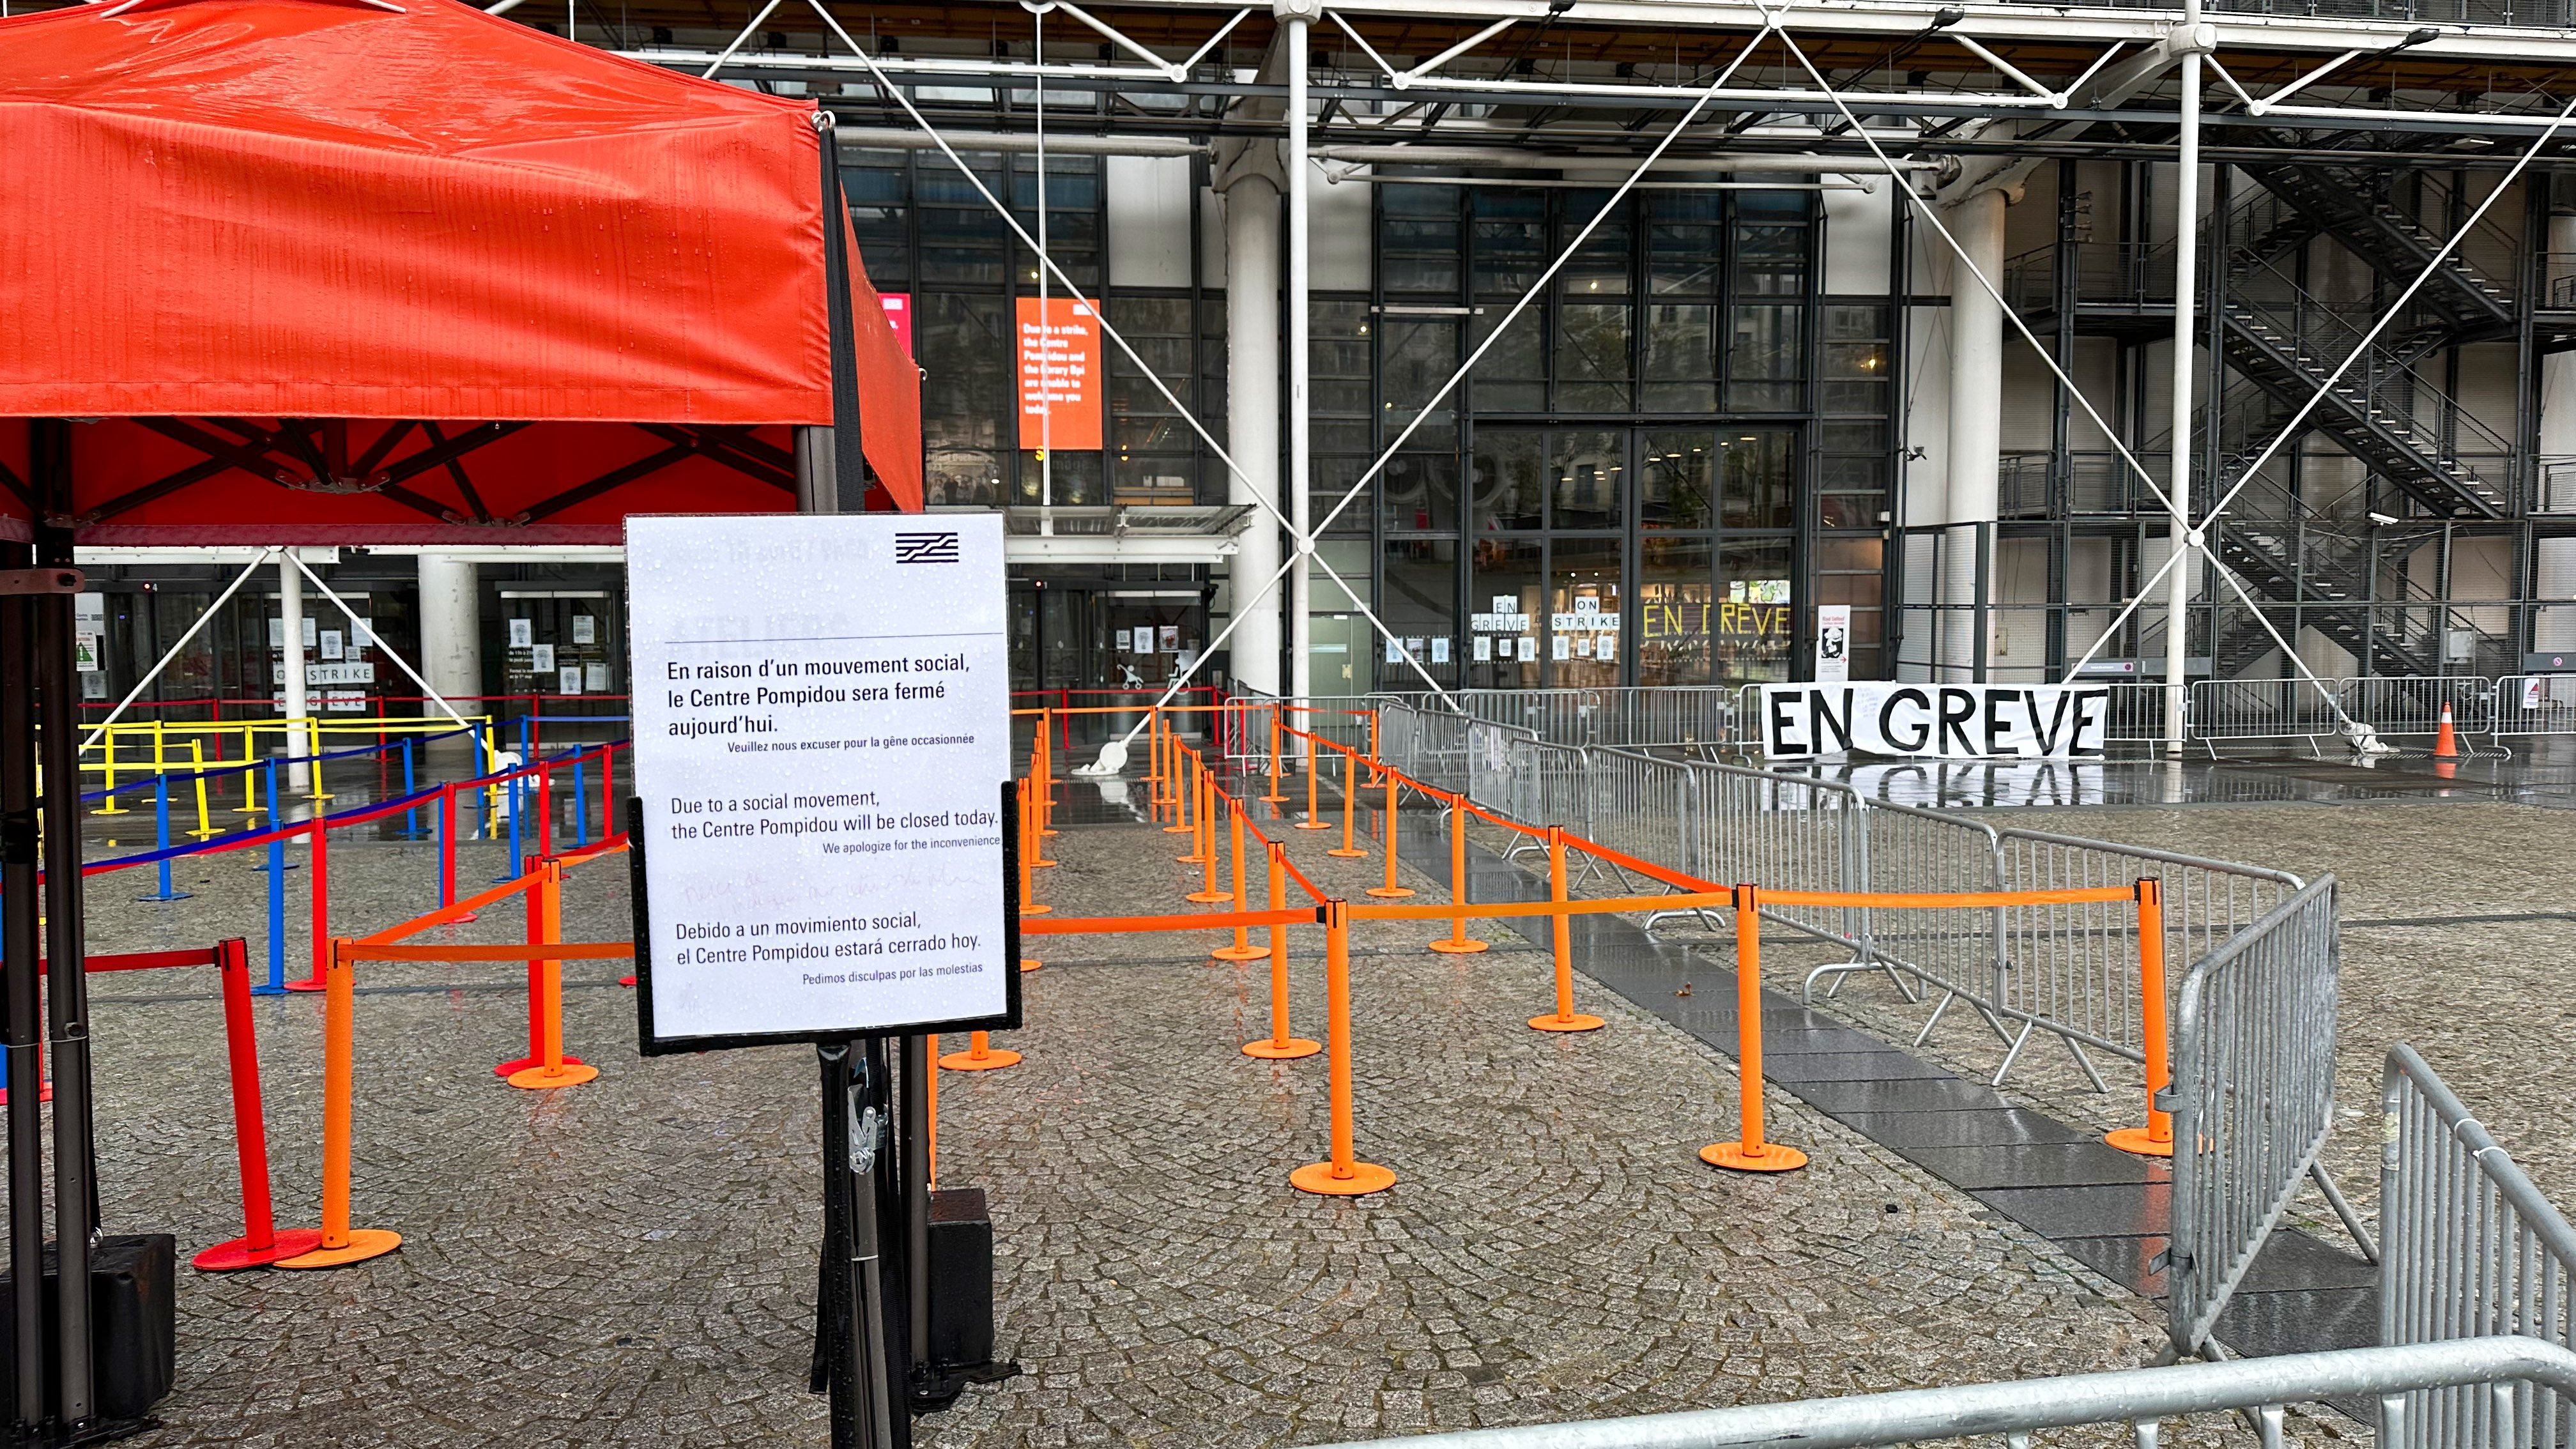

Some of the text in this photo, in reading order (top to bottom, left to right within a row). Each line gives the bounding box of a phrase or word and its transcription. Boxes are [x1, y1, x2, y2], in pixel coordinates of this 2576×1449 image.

[1023, 323, 1040, 334] Due
[1024, 390, 1064, 401] welme
[1496, 602, 1516, 613] EN
[1577, 601, 1597, 610] ON
[1471, 619, 1527, 631] GREVE
[1554, 617, 1619, 627] STRIKE
[1643, 604, 1683, 638] EN
[310, 668, 371, 681] STRIKE
[668, 653, 969, 680] En raison d'un mouvement social,
[668, 680, 945, 708] le Centre Pompidou sera fermé
[668, 714, 778, 740] aujourd'hui.
[1772, 688, 1854, 756] EN
[1879, 687, 2110, 757] GREVE
[727, 735, 974, 753] Veuillez nous excuser pour la gêne occasionnée
[671, 791, 880, 814] Due to a social movement,
[671, 809, 998, 839] the Centre Pompidou will be closed today.
[822, 837, 1000, 855] We apologize for the inconvenience
[676, 910, 921, 940] Debido a un movimiento social,
[677, 933, 981, 965] el Centre Pompidou estará cerrado hoy.
[802, 964, 983, 985] Pedimos disculpas por las molestias
